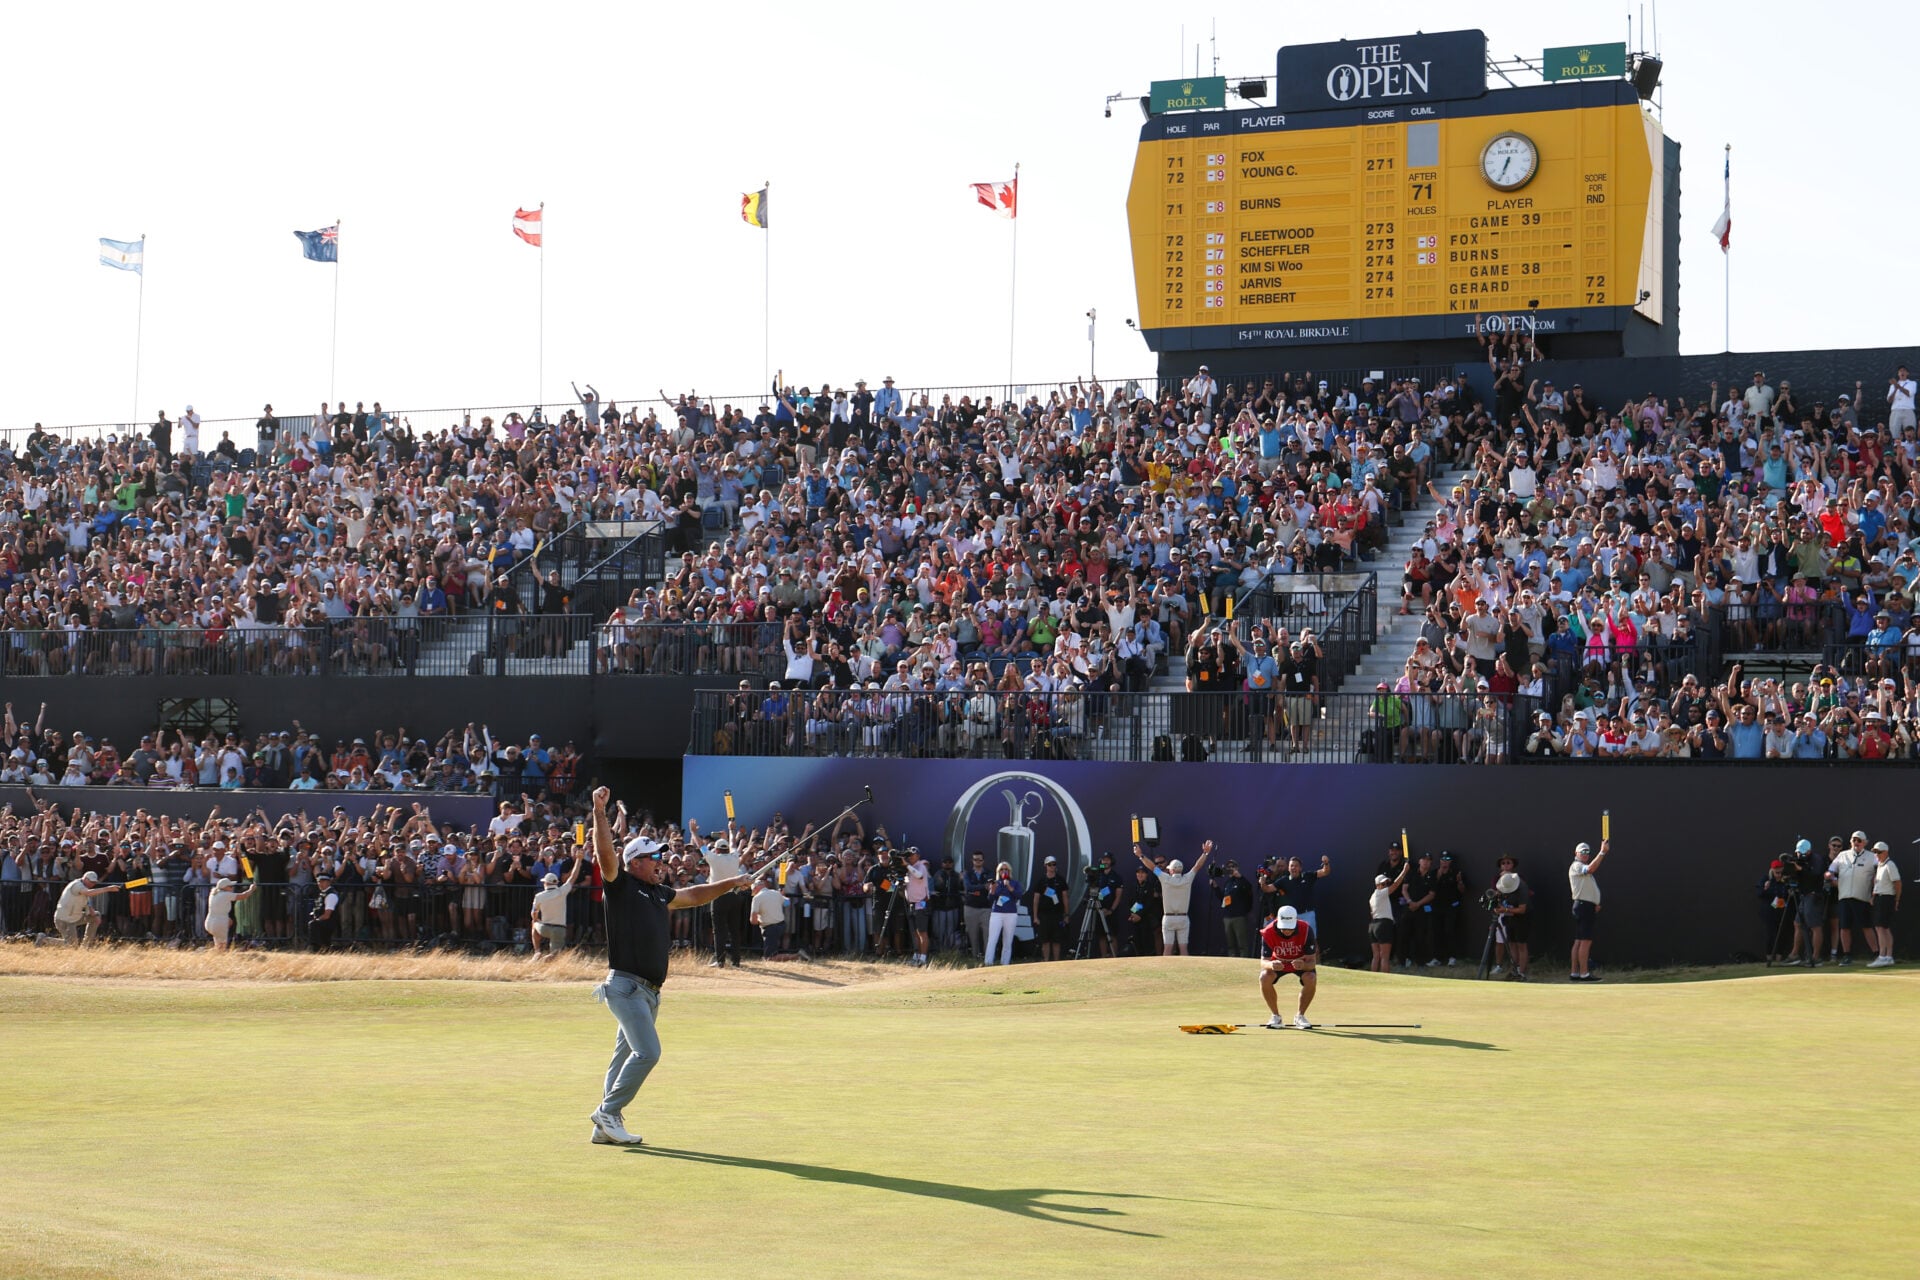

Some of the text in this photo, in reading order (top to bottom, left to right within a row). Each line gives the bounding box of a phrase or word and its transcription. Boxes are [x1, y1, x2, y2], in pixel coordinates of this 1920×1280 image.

[1357, 44, 1401, 64] THE
[1562, 64, 1606, 76] ROLEX
[1326, 61, 1431, 102] OPEN
[1167, 96, 1207, 108] ROLEX
[1167, 125, 1186, 133] HOLE
[1242, 116, 1285, 127] PLAYER
[1368, 110, 1394, 119] SCORE
[1411, 107, 1435, 115] CUML.
[1168, 157, 1182, 168] 71
[1242, 152, 1264, 162] FOX
[1168, 173, 1184, 183] 72
[1242, 166, 1283, 177] YOUNG
[1287, 166, 1297, 175] C.
[1367, 159, 1392, 170] 271
[1409, 172, 1436, 181] AFTER
[1584, 174, 1607, 182] SCORE
[1413, 184, 1431, 200] 71
[1589, 184, 1602, 192] FOR
[1488, 198, 1532, 210] PLAYER
[1587, 194, 1604, 203] RND
[1168, 204, 1182, 215] 71
[1241, 198, 1280, 210] BURNS
[1408, 206, 1436, 215] HOLES
[1471, 213, 1540, 228] GAME 39
[1167, 235, 1183, 246] 72
[1241, 228, 1314, 241] FLEETWOOD
[1367, 223, 1393, 234] 273
[1451, 234, 1477, 245] FOX
[1167, 251, 1183, 262] 72
[1241, 244, 1309, 257] SCHEFFLER
[1367, 239, 1394, 250] 273
[1451, 249, 1498, 261] BURNS
[1167, 267, 1182, 277] 72
[1241, 263, 1260, 273] KIM
[1264, 262, 1274, 272] Si
[1278, 261, 1302, 271] Woo
[1366, 255, 1393, 267] 274
[1470, 263, 1539, 277] GAME 38
[1166, 283, 1182, 293] 72
[1241, 277, 1281, 289] JARVIS
[1366, 271, 1393, 283] 274
[1450, 276, 1604, 294] GERARD 72
[1166, 298, 1182, 309] 72
[1241, 292, 1296, 304] HERBERT
[1366, 287, 1393, 299] 274
[1450, 292, 1604, 310] KIM 72
[1239, 327, 1348, 339] 154TH ROYAL BIRKDALE
[1274, 945, 1302, 956] OPEN
